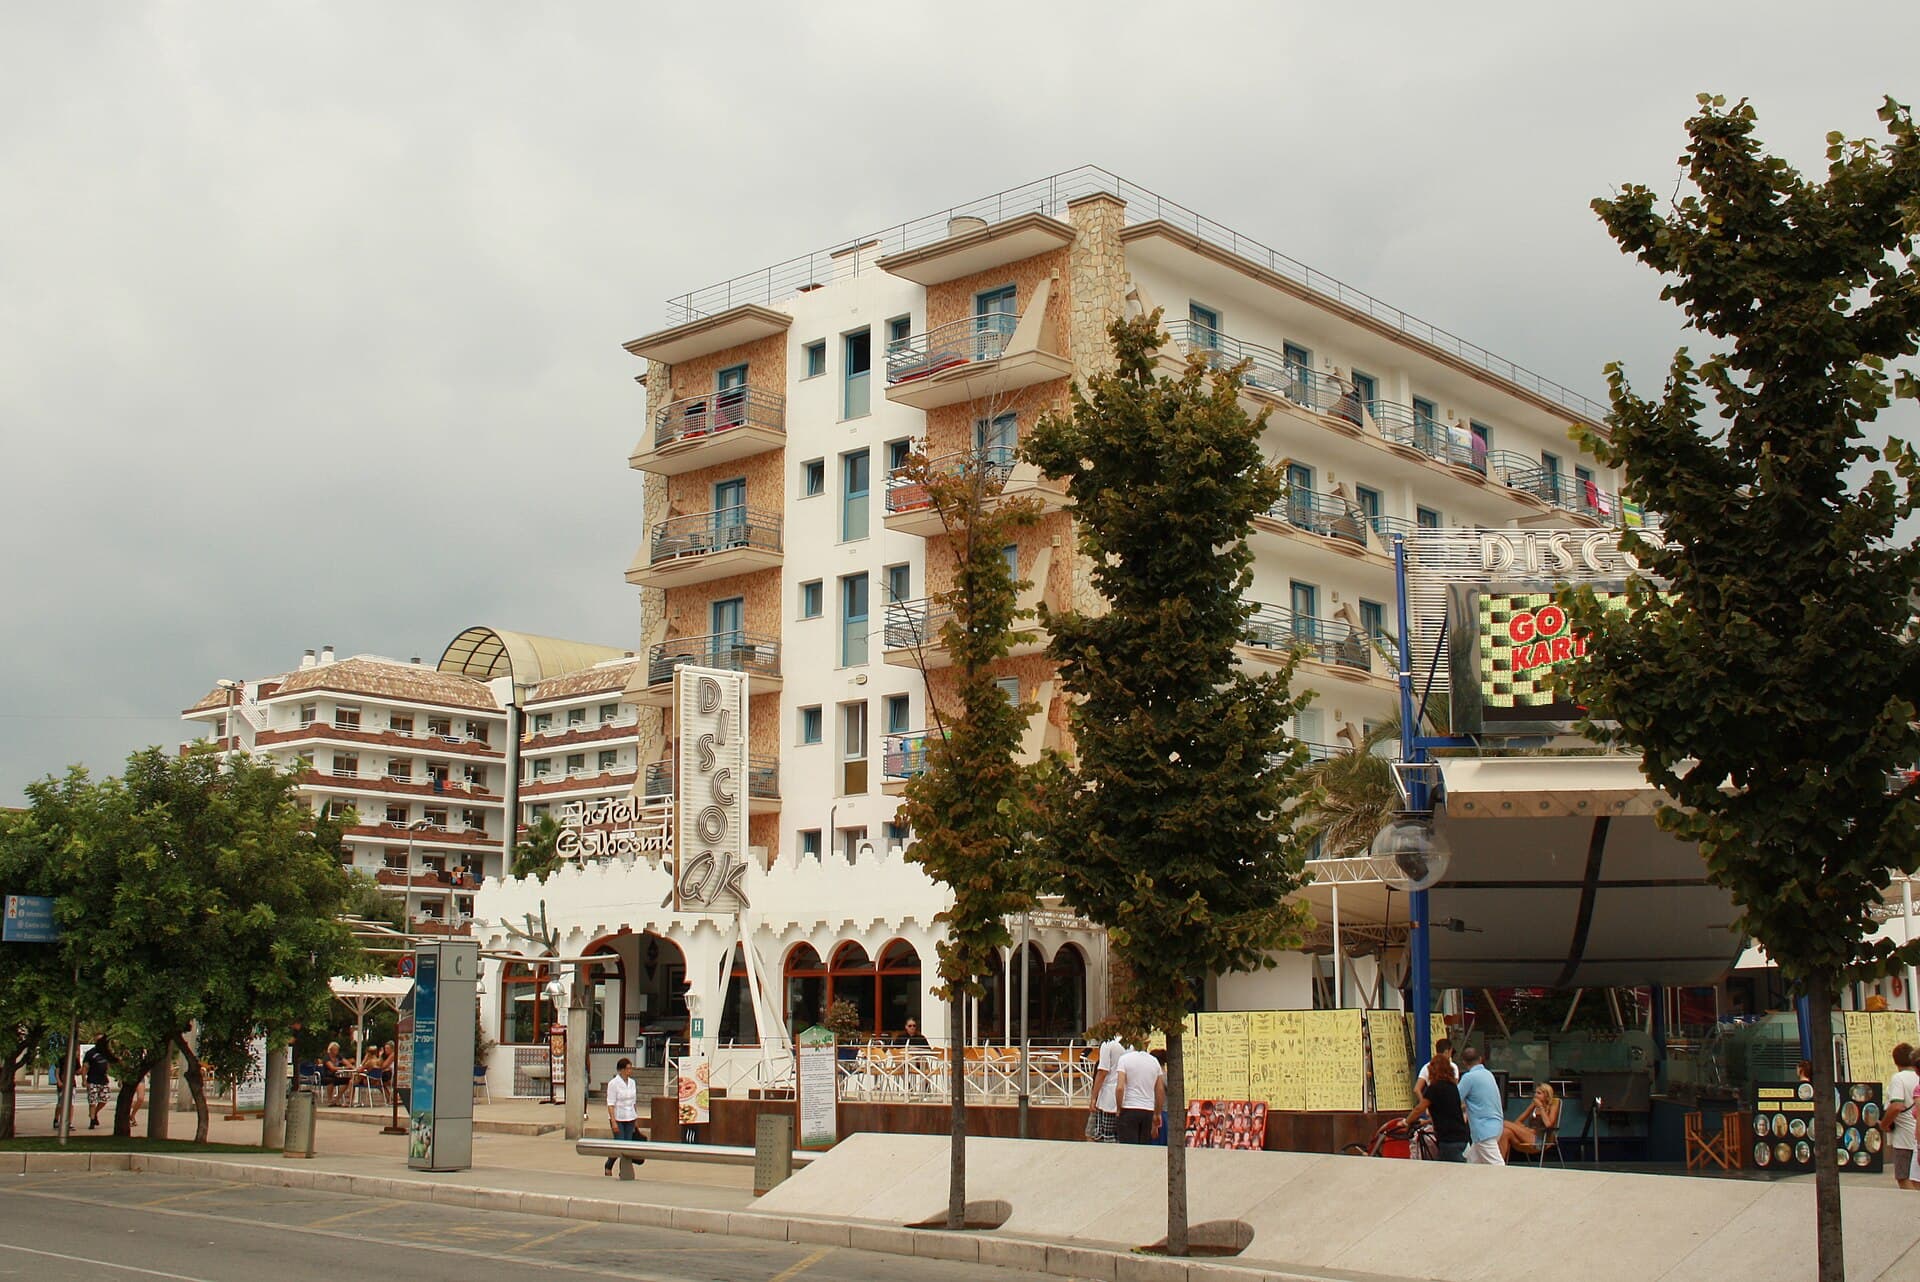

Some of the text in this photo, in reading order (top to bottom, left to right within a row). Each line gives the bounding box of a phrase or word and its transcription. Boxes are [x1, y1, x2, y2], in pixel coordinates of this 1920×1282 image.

[1480, 532, 1667, 573] DISCO
[1508, 605, 1567, 642] GO
[698, 677, 735, 845] DISCO
[694, 1020, 701, 1032] H
